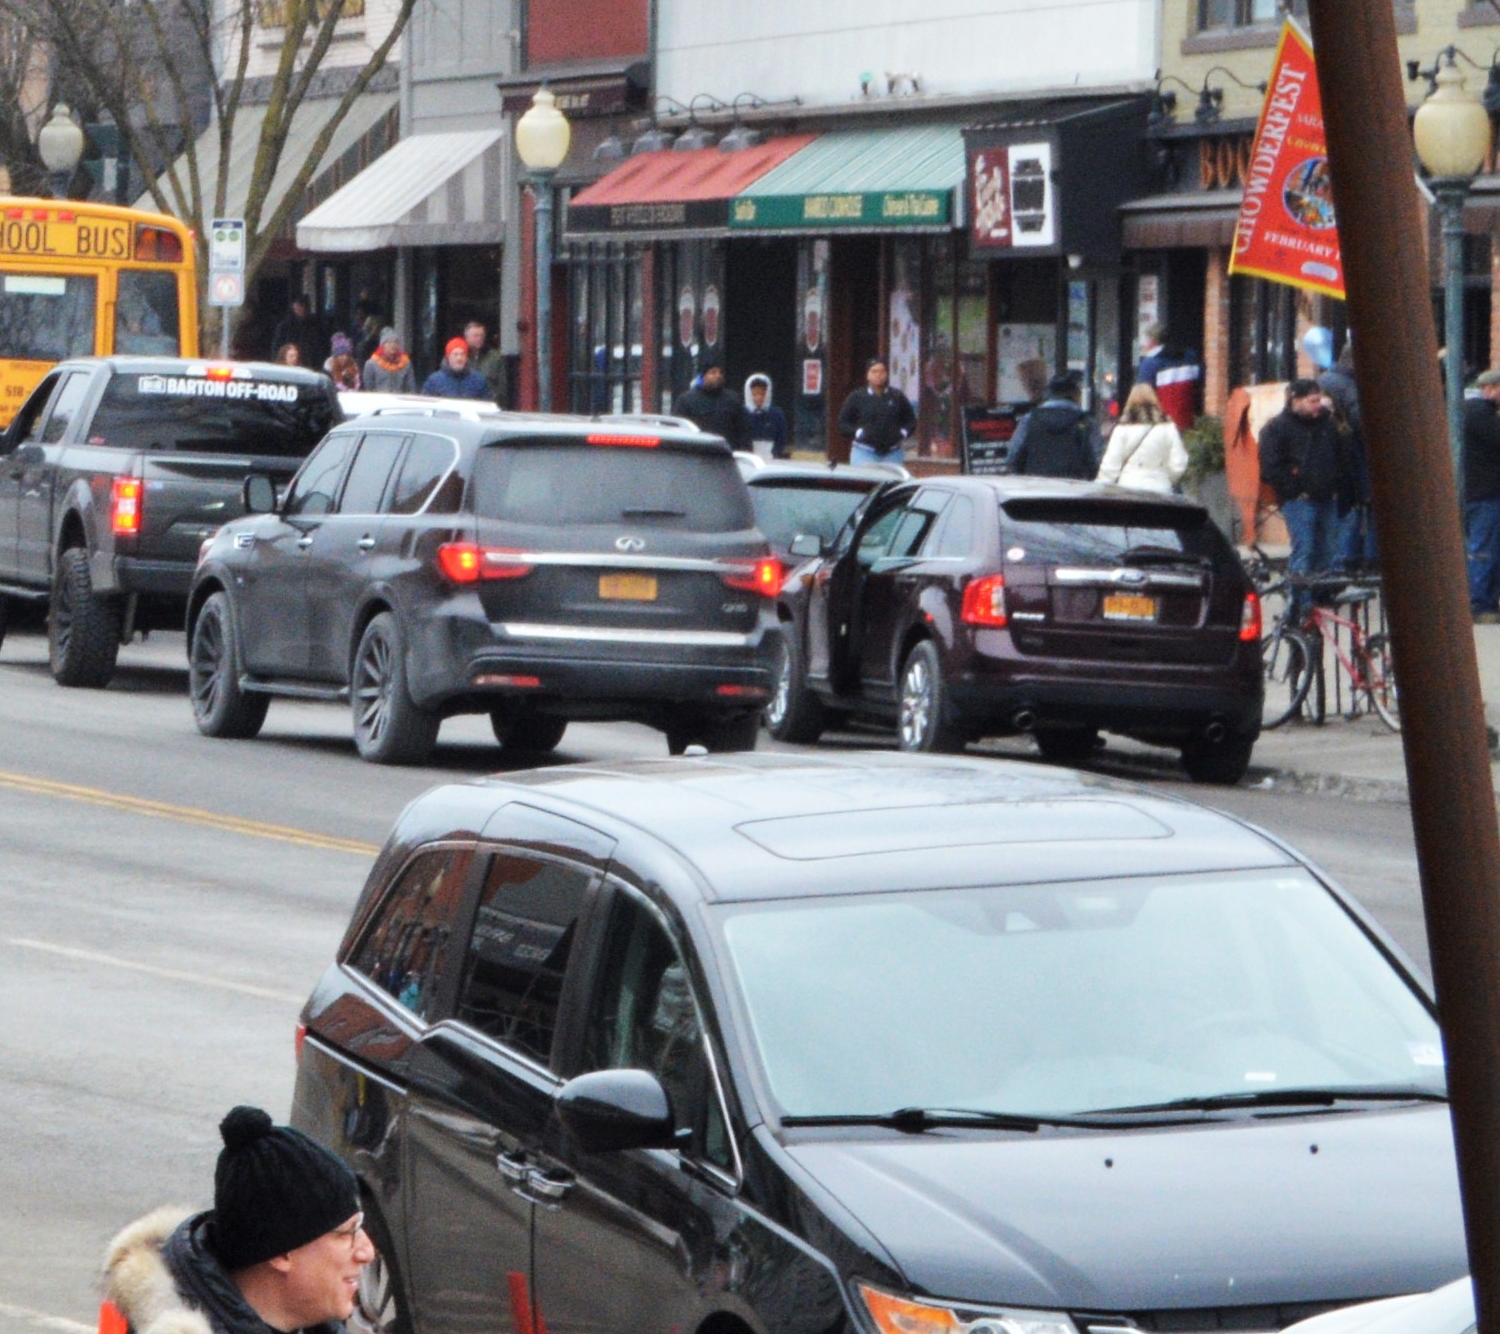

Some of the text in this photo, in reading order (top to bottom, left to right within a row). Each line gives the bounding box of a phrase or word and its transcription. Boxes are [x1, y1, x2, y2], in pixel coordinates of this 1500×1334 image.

[1234, 63, 1307, 254] CHOWDERFEST
[76, 225, 125, 256] BUS
[167, 378, 225, 398] BARTON
[227, 380, 298, 403] OFF-ROAD
